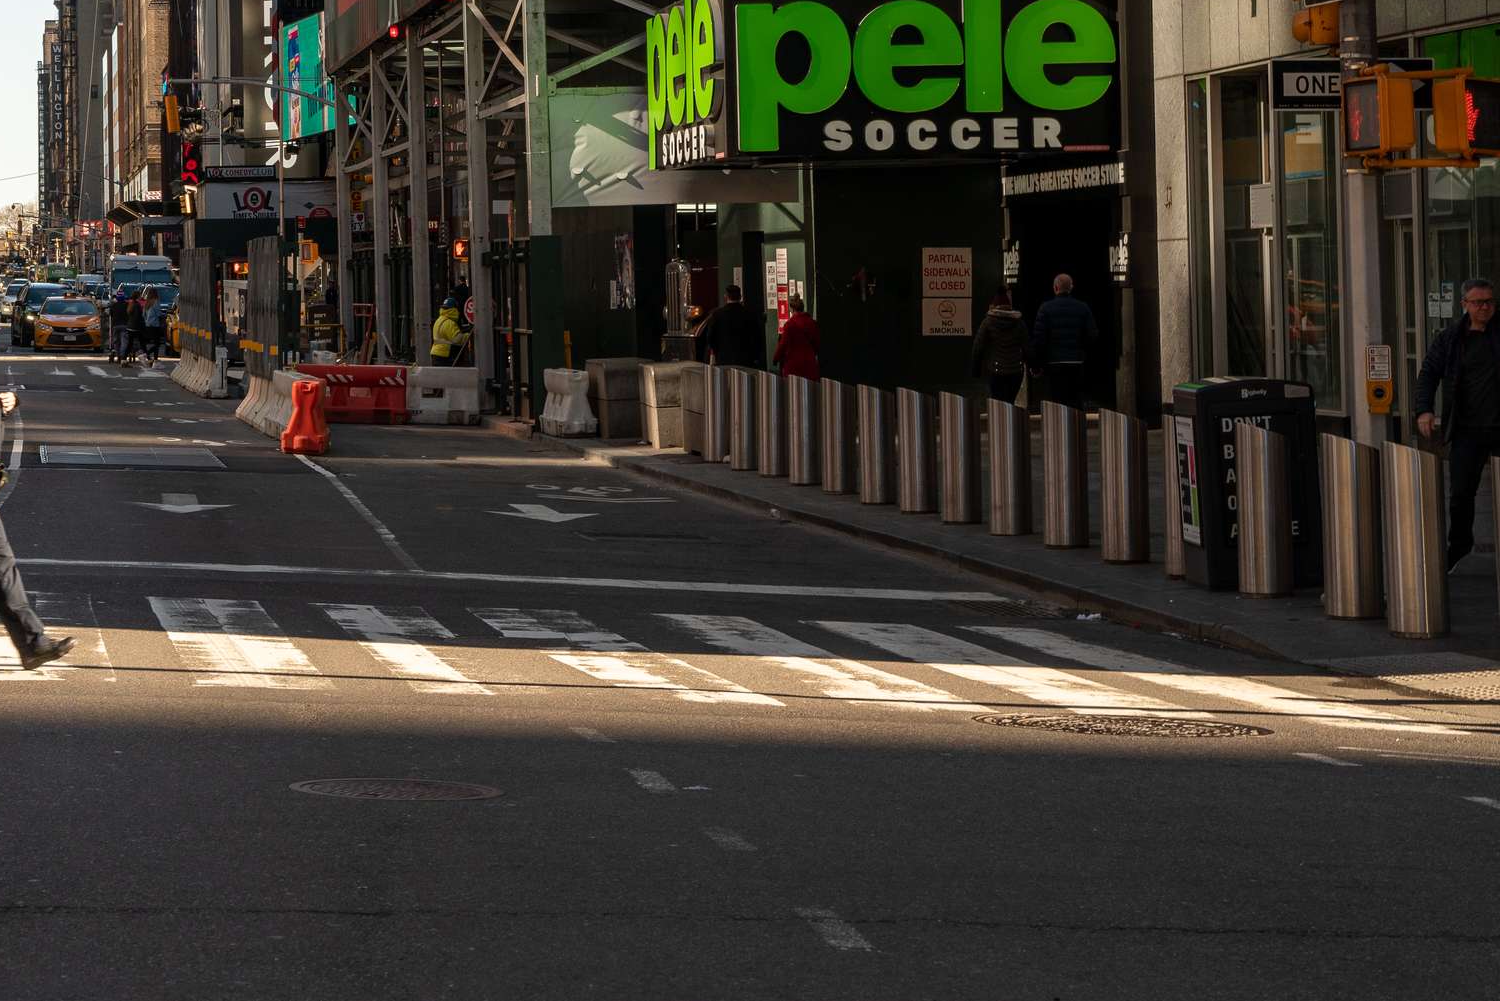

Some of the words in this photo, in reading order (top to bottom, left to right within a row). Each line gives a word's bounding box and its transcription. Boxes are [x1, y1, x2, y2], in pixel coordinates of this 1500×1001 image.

[1296, 76, 1341, 94] ONE
[662, 124, 707, 167] SOCCER
[823, 117, 1062, 152] SOCCER
[1001, 175, 1014, 197] THE
[1013, 172, 1040, 196] WORLD'S
[1040, 168, 1073, 193] GREATEST
[1073, 164, 1100, 190] SOCCER
[1100, 161, 1125, 186] STORE
[233, 187, 275, 212] LOL
[928, 254, 965, 264] PARTIAL
[1108, 233, 1128, 273] pelé
[923, 267, 970, 277] SIDEWALK
[929, 281, 966, 290] CLOSED
